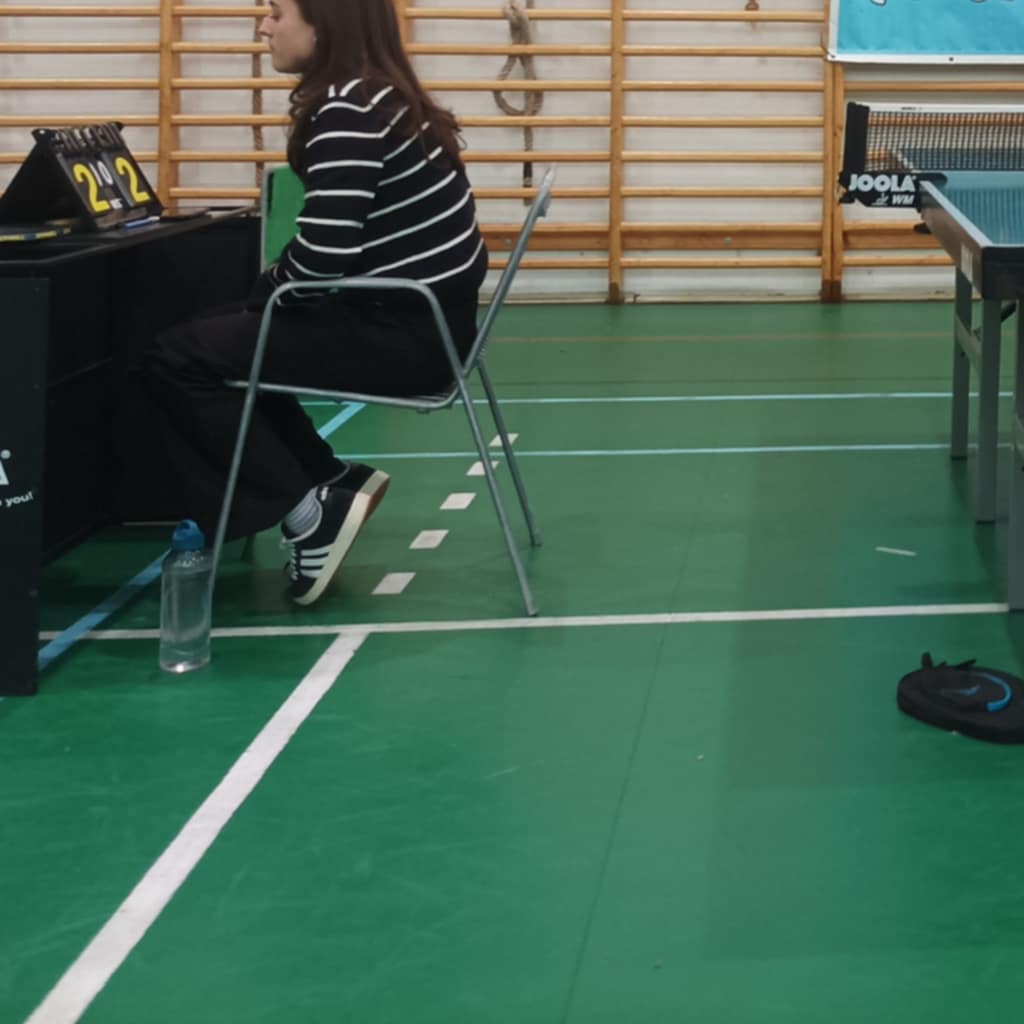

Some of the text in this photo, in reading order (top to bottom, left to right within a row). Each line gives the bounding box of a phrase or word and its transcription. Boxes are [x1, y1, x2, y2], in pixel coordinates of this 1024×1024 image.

[73, 163, 110, 212] 2
[115, 157, 150, 202] 2
[848, 174, 916, 192] JOOLA
